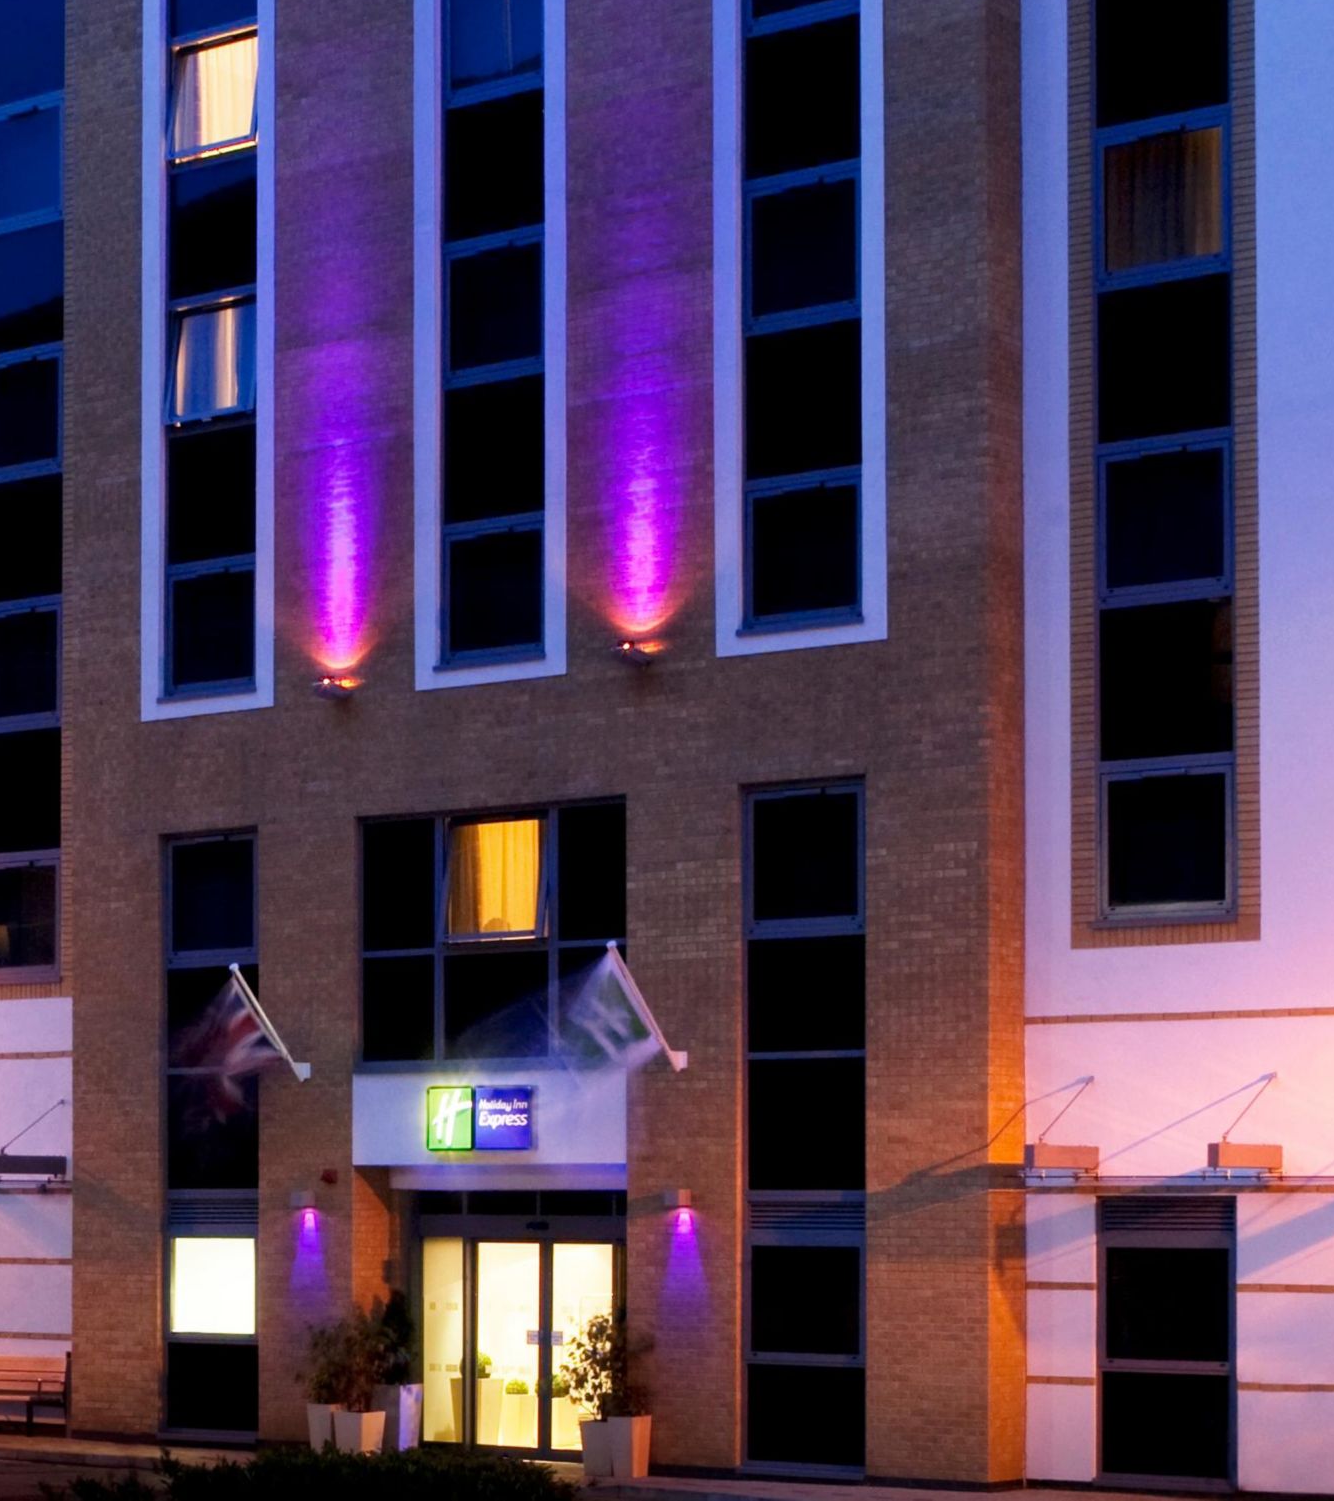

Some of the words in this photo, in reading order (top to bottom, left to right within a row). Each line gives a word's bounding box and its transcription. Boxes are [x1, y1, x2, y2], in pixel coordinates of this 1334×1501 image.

[478, 1098, 512, 1112] Holiday
[513, 1098, 528, 1109] Inn
[478, 1110, 528, 1129] Express
